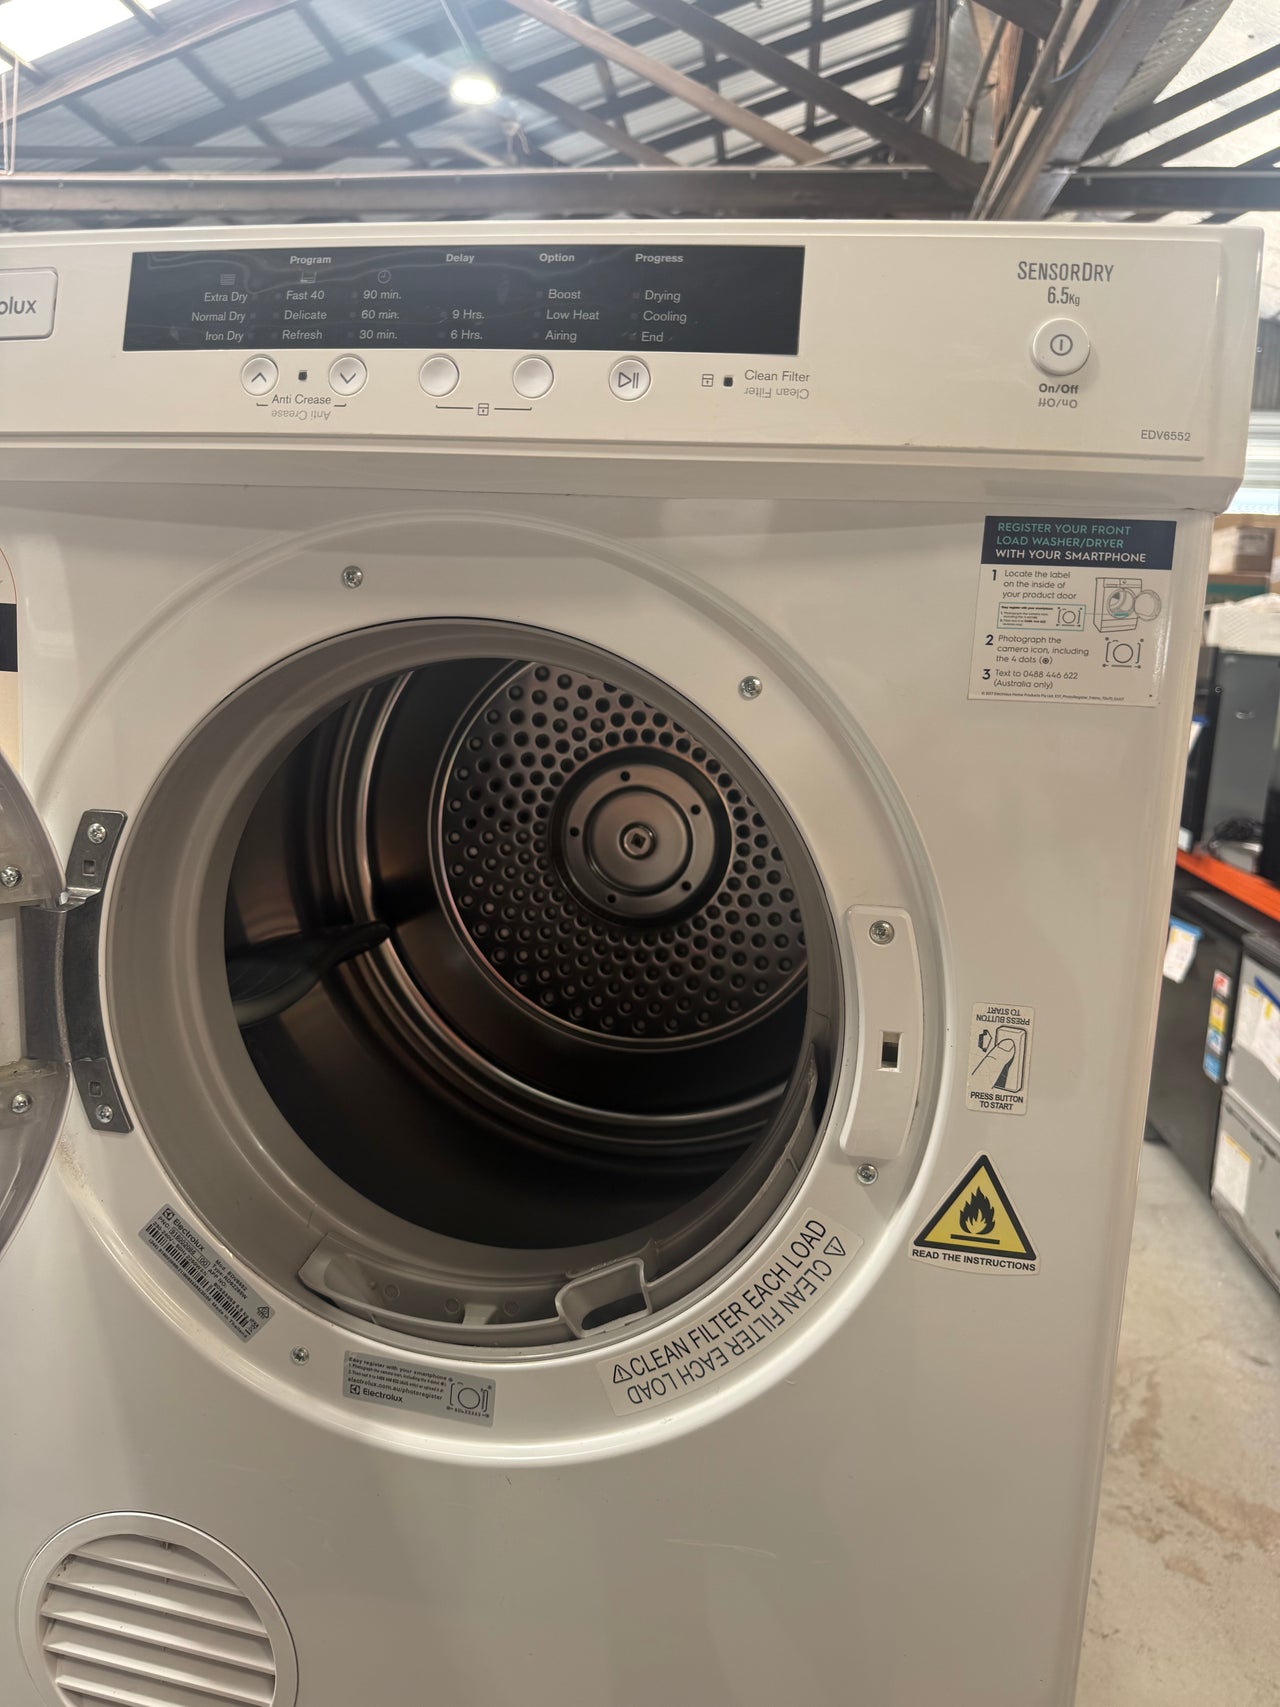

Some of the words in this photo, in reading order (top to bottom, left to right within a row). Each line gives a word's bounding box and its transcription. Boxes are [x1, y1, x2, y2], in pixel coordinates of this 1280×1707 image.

[290, 255, 331, 266] Program
[446, 253, 475, 265] Delay
[539, 253, 575, 265] Option
[635, 253, 684, 265] Progress
[1017, 261, 1114, 282] SENSORDRY
[204, 291, 229, 302] Extra
[231, 291, 248, 304] Dry
[286, 290, 307, 300] Fast
[309, 290, 325, 300] 40
[363, 290, 379, 300] 90
[380, 290, 402, 300] min.
[548, 289, 581, 300] Boost
[644, 290, 681, 303] Drying
[1047, 286, 1081, 306] 6.5Kg
[191, 311, 227, 322] Normal
[229, 311, 246, 324] Dry
[284, 310, 327, 321] Delicate
[361, 310, 376, 320] 60
[377, 309, 400, 320] min.
[452, 309, 460, 320] 9
[463, 309, 486, 320] Hrs.
[546, 309, 571, 320] Low
[573, 310, 600, 321] Heat
[643, 311, 687, 324] Cooling
[205, 331, 225, 341] Iron
[226, 331, 244, 343] Dry
[282, 329, 323, 340] Refresh
[359, 329, 374, 340] 30
[375, 329, 398, 340] min.
[450, 330, 458, 340] 6
[461, 330, 483, 341] Hrs.
[545, 330, 577, 343] Airing
[641, 331, 664, 342] End
[744, 370, 779, 382] Clean
[782, 371, 810, 383] Filter
[743, 387, 772, 400] Filter
[775, 388, 810, 400] Clean
[1038, 383, 1080, 395] On/Off
[272, 394, 293, 405] Anti
[294, 394, 332, 406] Crease
[1038, 398, 1078, 409] On/Off
[271, 409, 308, 421] Crease
[310, 409, 332, 421] Anti
[1140, 429, 1192, 442] EDV6552
[998, 522, 1052, 534] REGISTER
[1054, 524, 1088, 535] YOUR
[1091, 525, 1132, 536] FRONT
[996, 536, 1029, 546] LOAD
[1031, 537, 1124, 549] WASHER/DRYER
[995, 549, 1025, 559] WITH
[1028, 550, 1062, 561] YOUR
[1064, 551, 1147, 563] SMARTPHONE
[991, 569, 997, 581] 1
[1004, 570, 1033, 578] Locate
[1034, 570, 1048, 578] the
[1049, 571, 1071, 579] label
[1031, 581, 1055, 589] inside
[1056, 581, 1066, 589] of
[1002, 591, 1020, 600] your
[1022, 591, 1055, 601] product
[1056, 592, 1077, 600] door
[985, 634, 994, 646] 2
[998, 635, 1046, 645] Photograph
[1048, 636, 1062, 644] the
[1030, 646, 1050, 655] icon,
[1051, 647, 1090, 657] including
[995, 655, 1009, 663] the
[1018, 656, 1037, 664] dots
[982, 668, 991, 680] 3
[995, 669, 1012, 677] Text
[1012, 670, 1022, 678] to
[1022, 670, 1044, 679] 0488
[1045, 671, 1062, 679] 446
[1063, 671, 1079, 680] 622
[993, 679, 1032, 689] (Australia
[1033, 680, 1054, 690] only)
[986, 1007, 1008, 1016] START
[1010, 1007, 1021, 1017] TO
[976, 1014, 1005, 1024] BUTTON
[1006, 1016, 1031, 1026] PRESS
[970, 1091, 994, 1101] PRESS
[995, 1093, 1024, 1104] BUTTON
[979, 1100, 990, 1109] TO
[991, 1101, 1014, 1111] START
[172, 1218, 205, 1251] Electrolux
[912, 1249, 940, 1260] READ
[942, 1253, 961, 1263] THE
[963, 1255, 1036, 1272] INSTRUCTIONS
[780, 1259, 833, 1315] CLEAN
[629, 1337, 691, 1376] CLEAN
[688, 1301, 749, 1350] FILTER
[742, 1262, 792, 1310] EACH
[782, 1219, 826, 1269] LOAD
[724, 1306, 785, 1357] FILTER
[676, 1346, 730, 1386] EACH
[362, 1387, 403, 1402] Electrolux
[627, 1372, 678, 1405] LOAD
